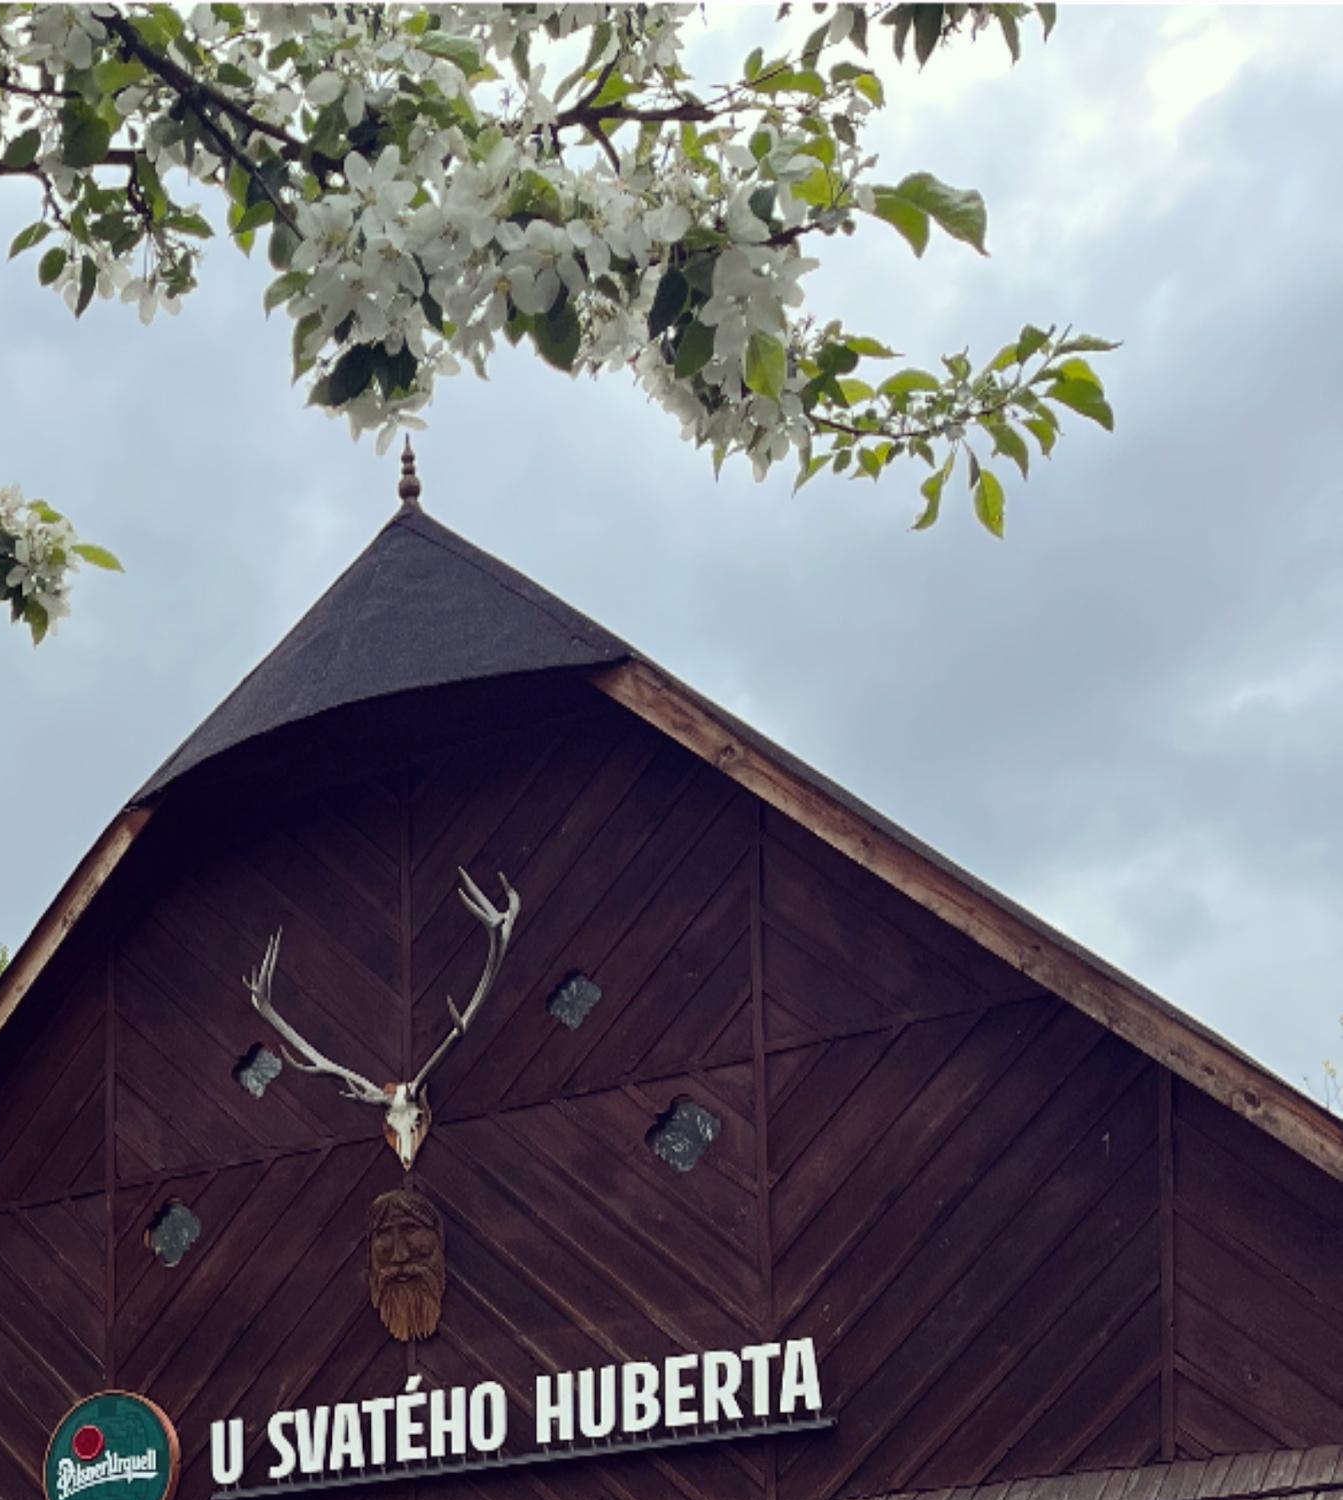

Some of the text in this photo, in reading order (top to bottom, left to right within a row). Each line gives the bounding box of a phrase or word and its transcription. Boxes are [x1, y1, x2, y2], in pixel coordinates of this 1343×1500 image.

[210, 1337, 822, 1485] U SVATÉHO HUBERTA
[56, 1448, 157, 1500] Pilsner Urquell
